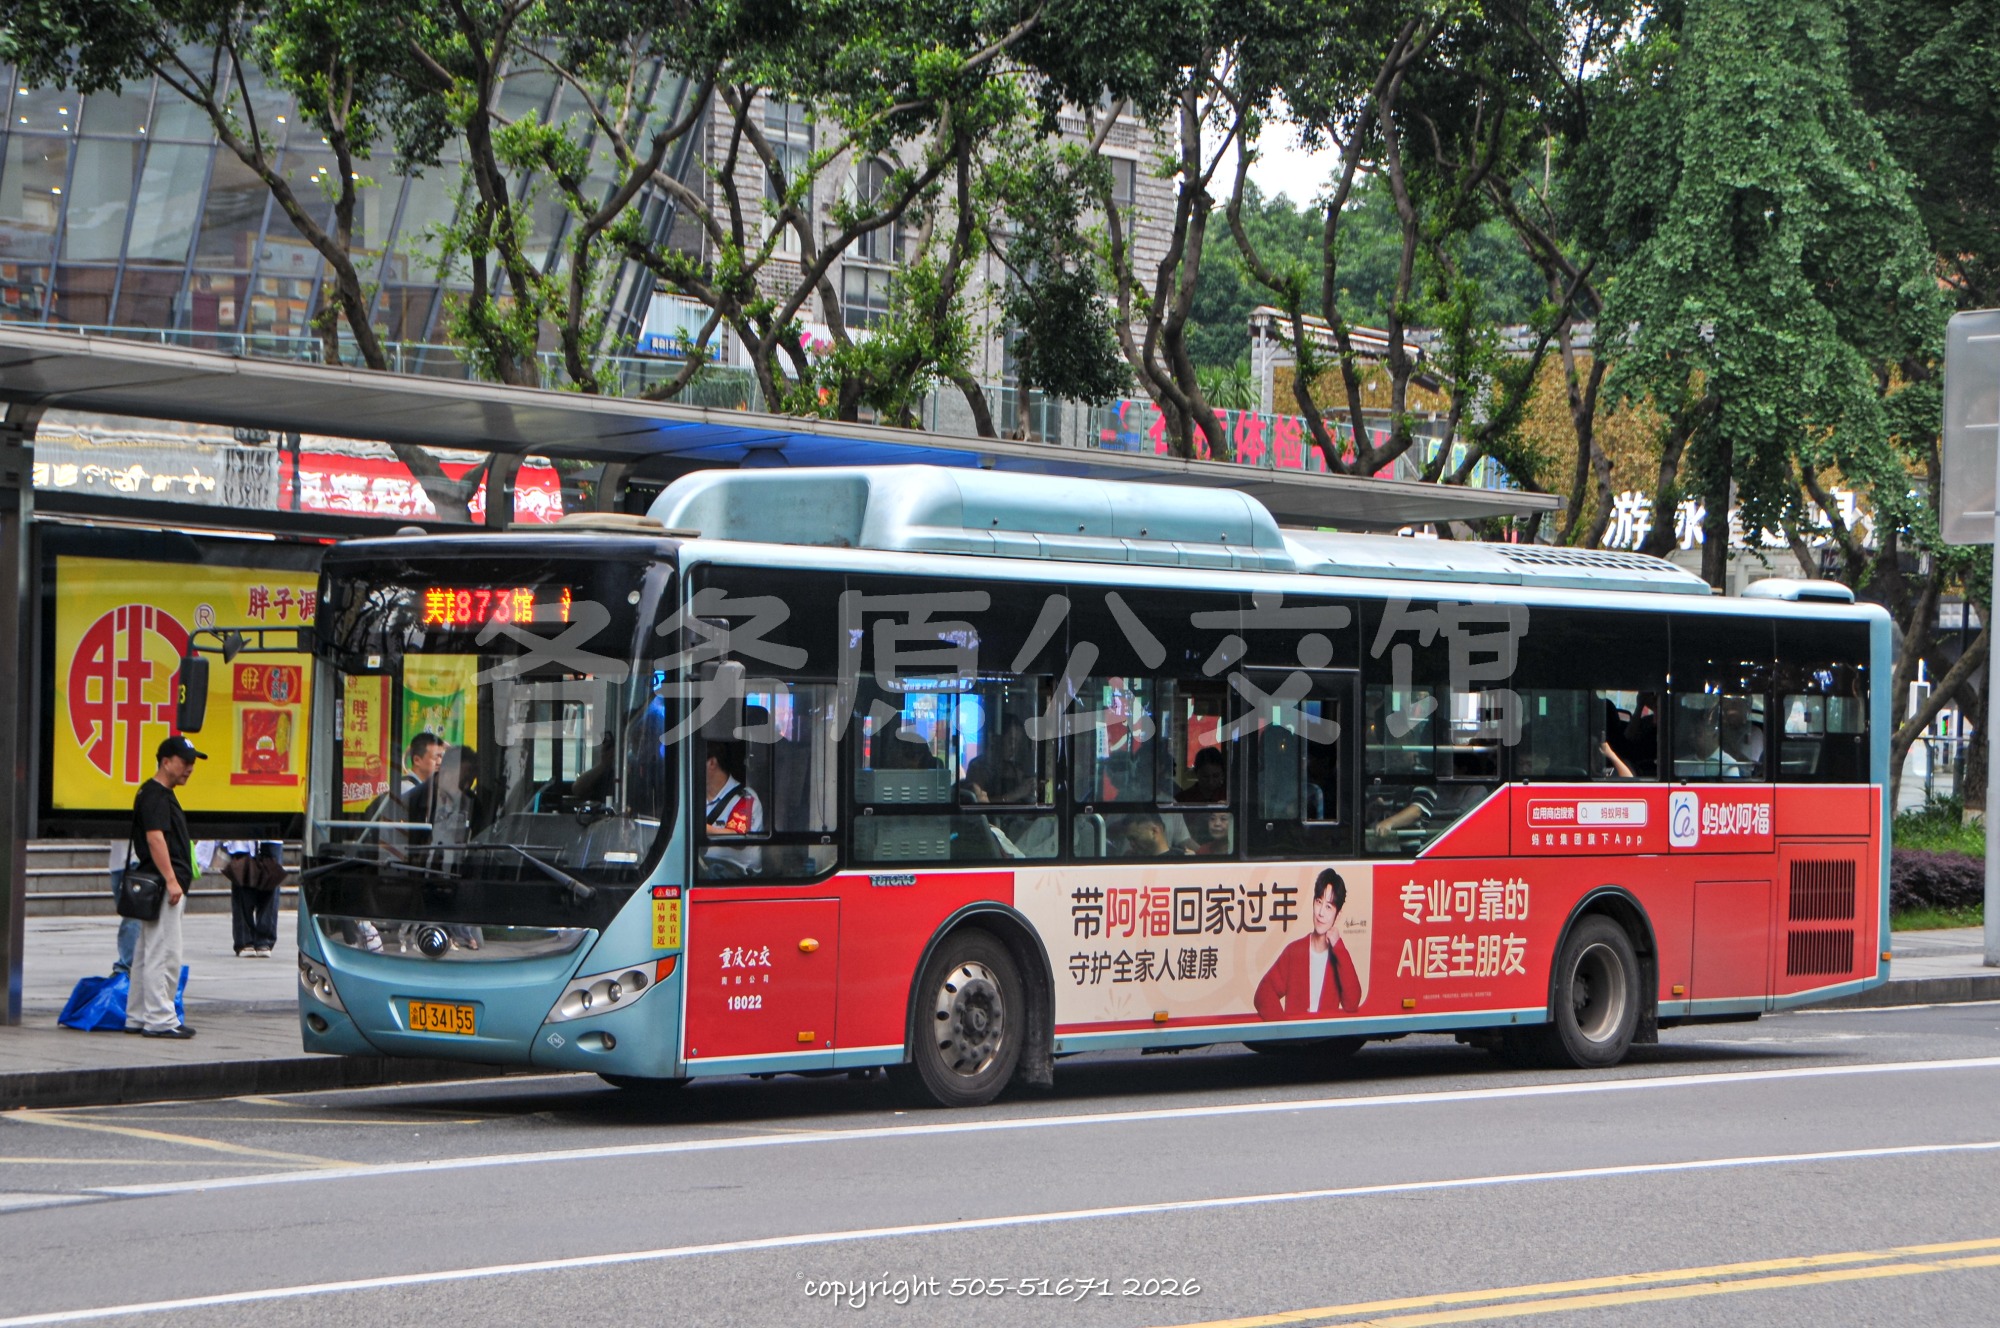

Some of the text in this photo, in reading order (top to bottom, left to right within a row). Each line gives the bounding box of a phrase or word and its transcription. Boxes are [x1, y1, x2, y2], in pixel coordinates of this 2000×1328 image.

[1600, 807, 1629, 819] 蚂蚁阿福
[1701, 802, 1770, 836] 蚂蚁阿福
[1070, 882, 1299, 939] 带阿福回家过年
[1399, 878, 1529, 925] 专业可靠的
[719, 945, 771, 969] 重庆公交
[1068, 946, 1219, 986] 守护全家人健康
[1396, 931, 1527, 980] AI医生朋友
[727, 995, 762, 1010] 18022
